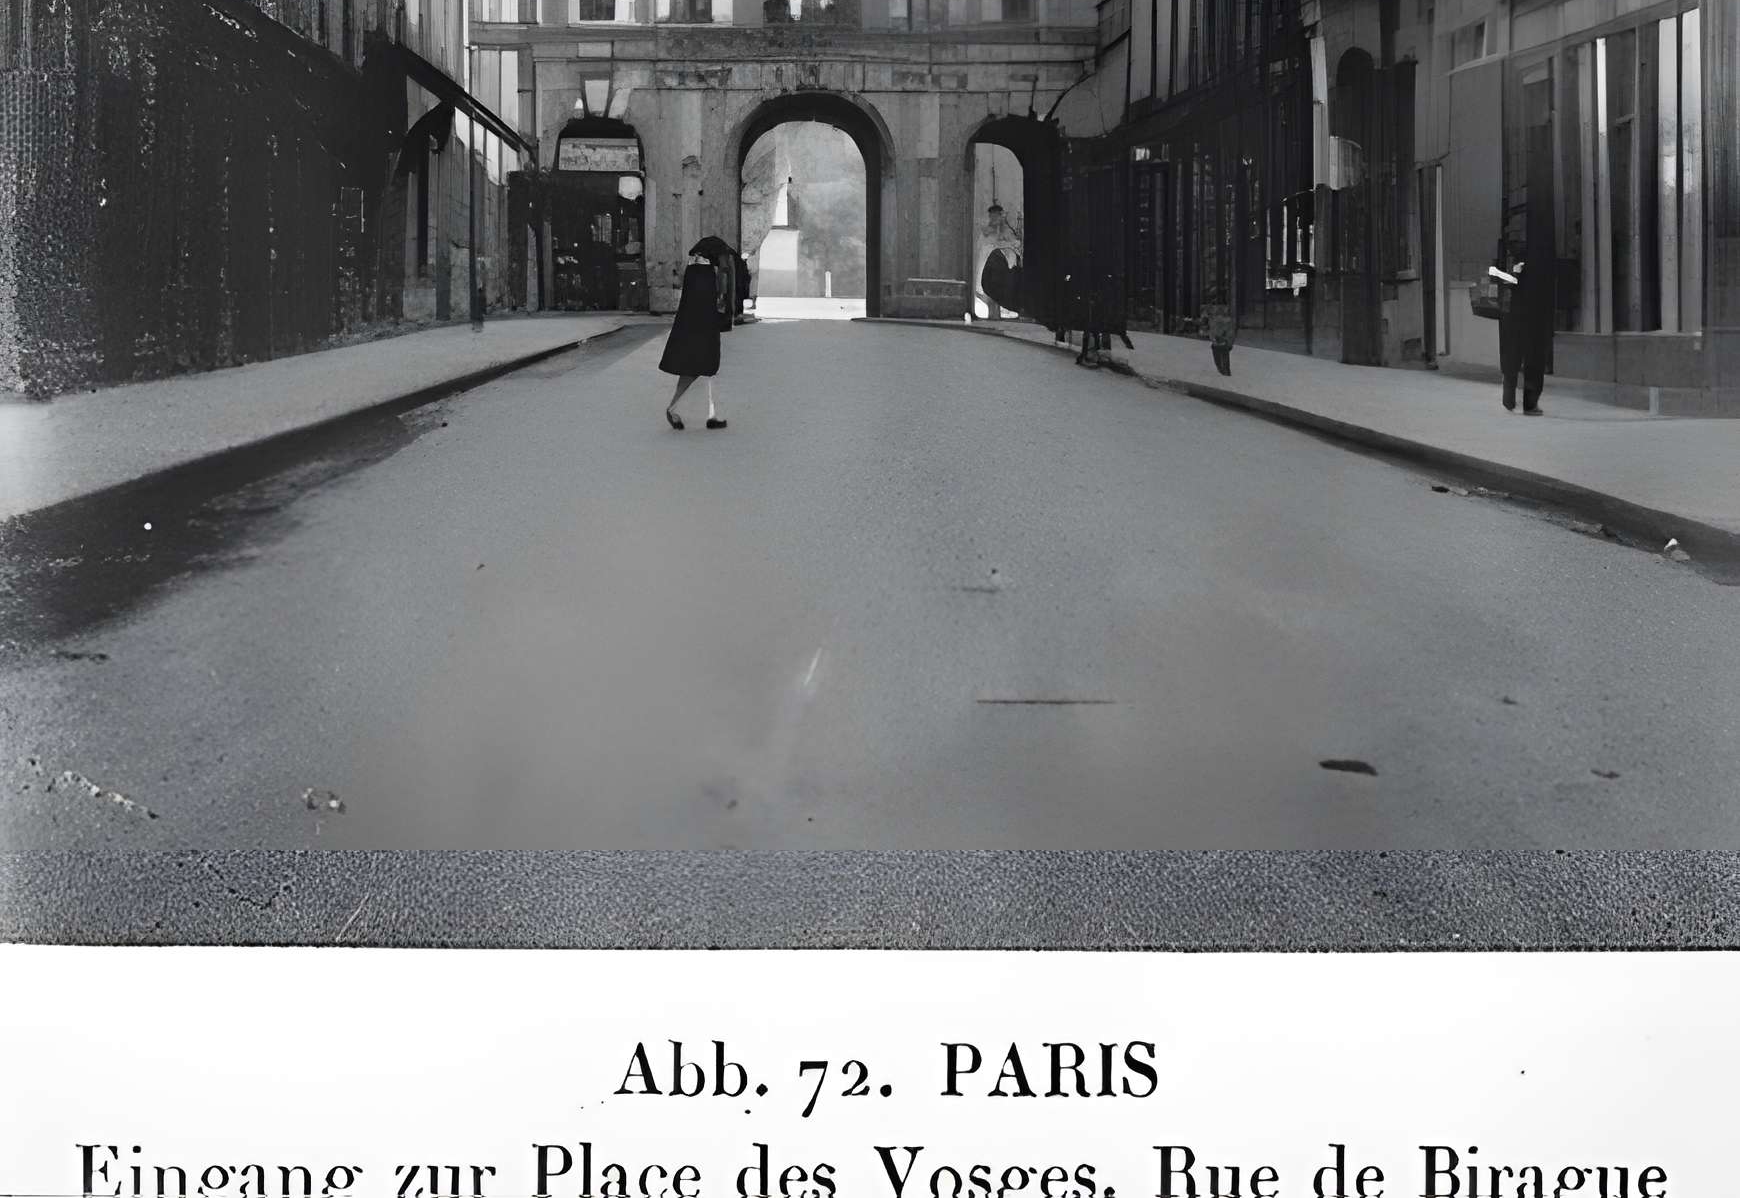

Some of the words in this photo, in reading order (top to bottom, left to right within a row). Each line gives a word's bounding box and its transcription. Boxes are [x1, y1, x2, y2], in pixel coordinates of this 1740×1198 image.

[613, 1039, 769, 1098] Abb.
[798, 1059, 893, 1119] 72.
[940, 1040, 1158, 1098] PARIS
[74, 1143, 364, 1198] Eingang
[395, 1165, 497, 1198] zur
[531, 1141, 702, 1198] Place
[736, 1142, 837, 1198] des
[1152, 1145, 1280, 1198] Rue
[1313, 1143, 1385, 1198] de
[1418, 1145, 1668, 1198] Birague
